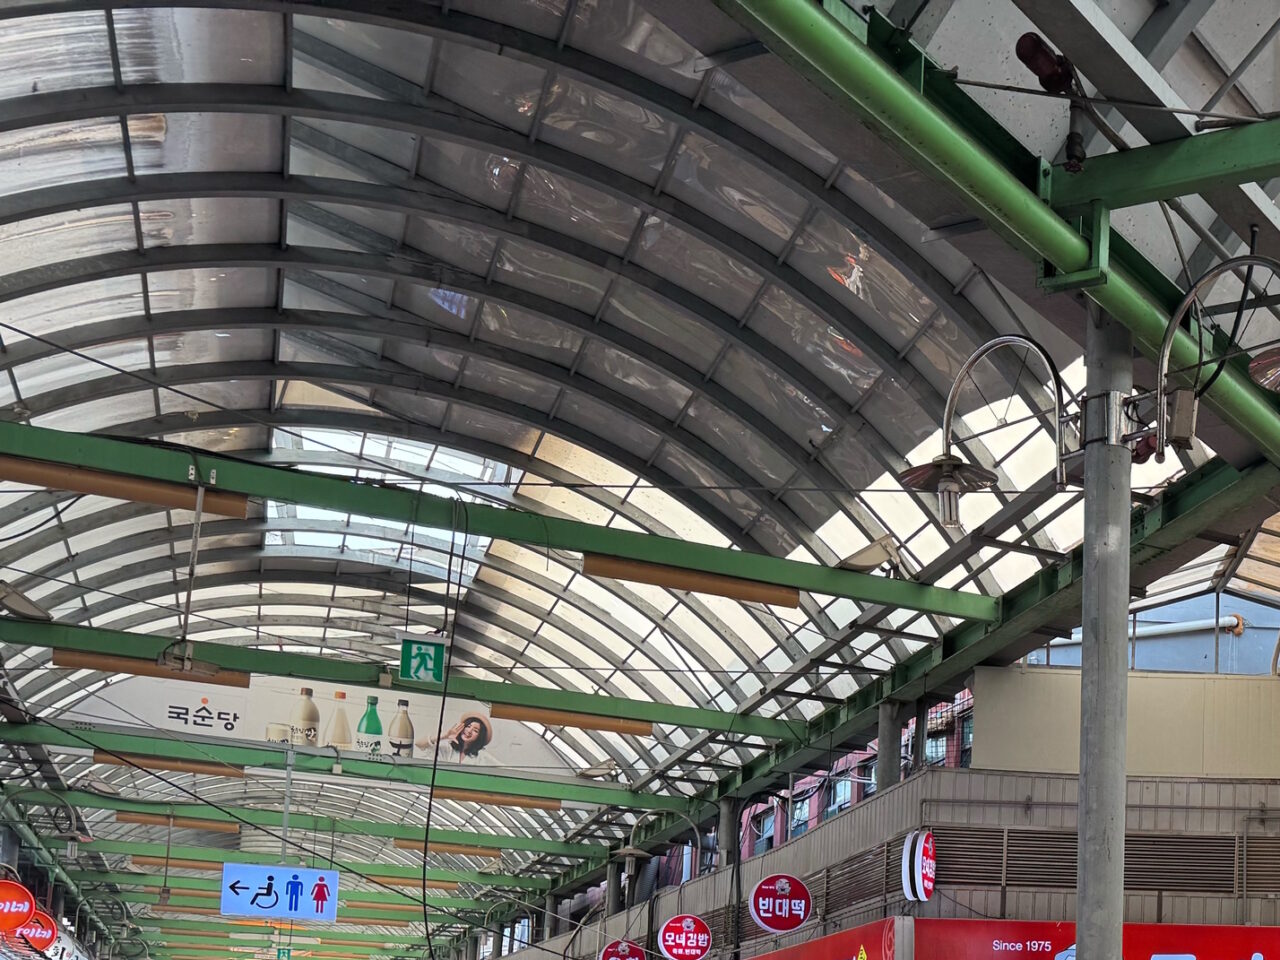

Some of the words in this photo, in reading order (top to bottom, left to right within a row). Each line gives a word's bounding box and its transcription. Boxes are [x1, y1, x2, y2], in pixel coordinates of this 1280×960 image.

[167, 703, 240, 731] 국순당
[758, 896, 806, 920] 빈대떡
[664, 931, 710, 947] 모녀김밥
[992, 940, 1023, 951] Since
[1025, 941, 1052, 952] 1975
